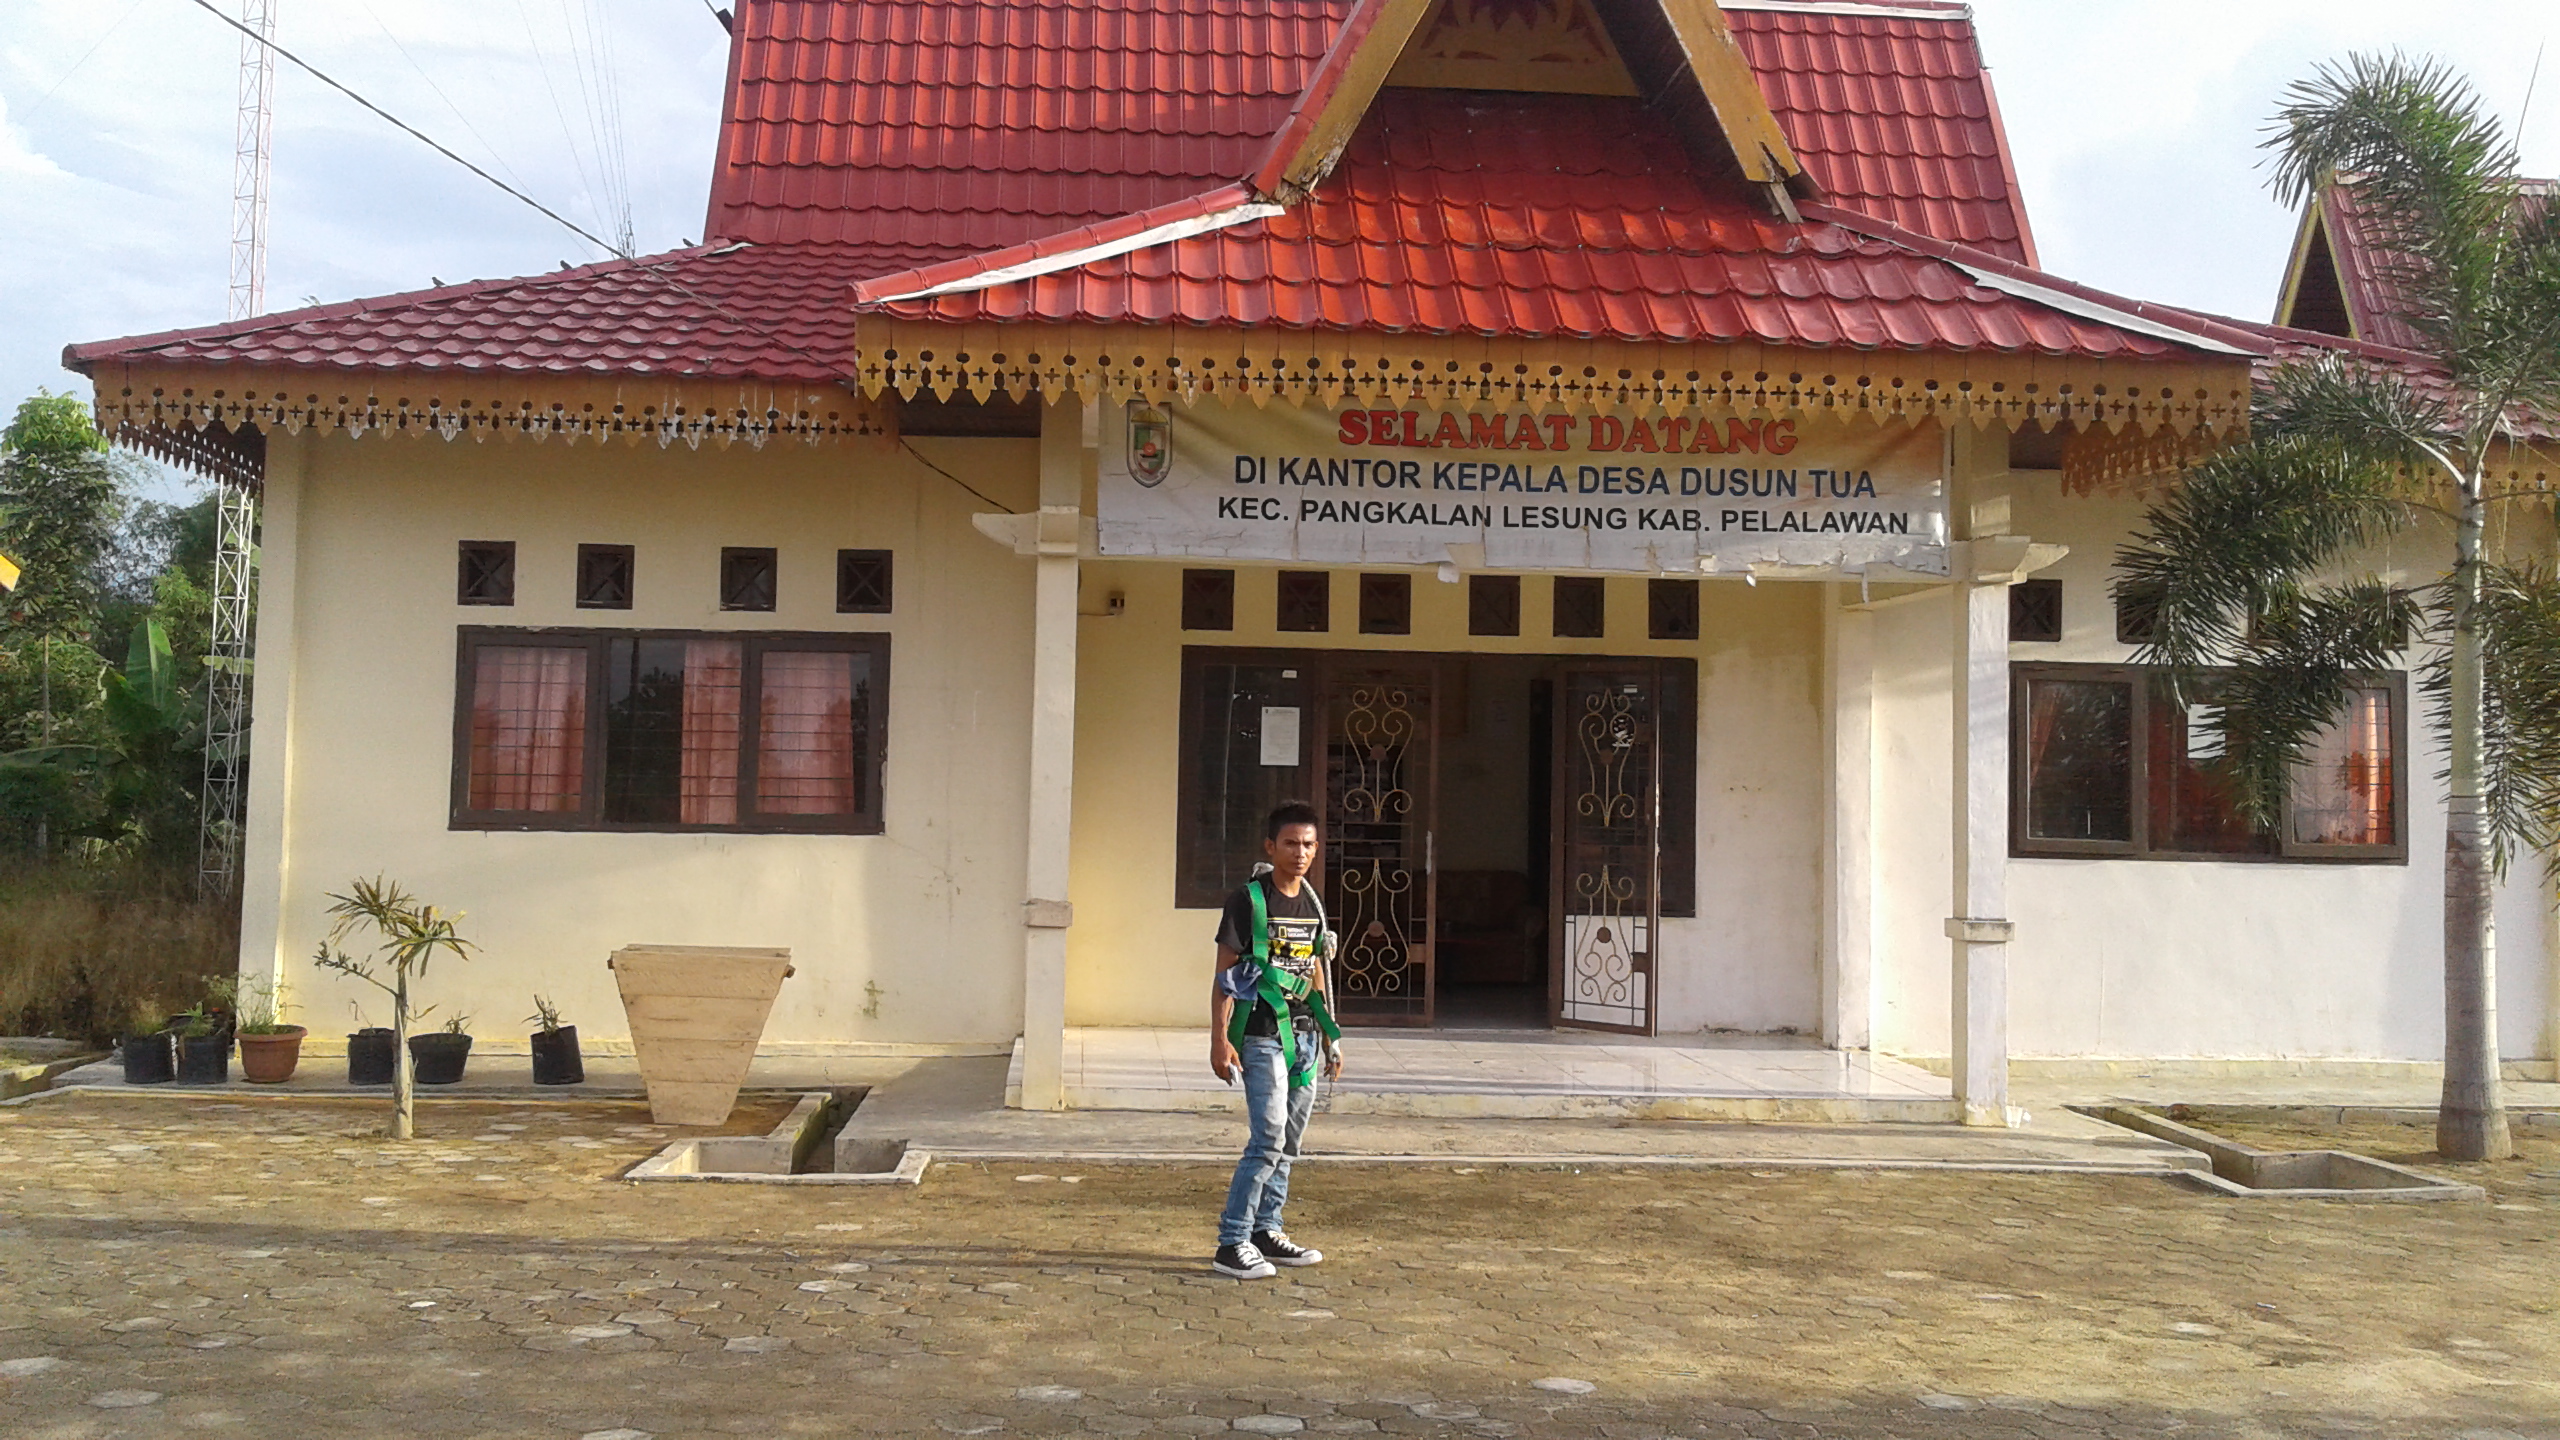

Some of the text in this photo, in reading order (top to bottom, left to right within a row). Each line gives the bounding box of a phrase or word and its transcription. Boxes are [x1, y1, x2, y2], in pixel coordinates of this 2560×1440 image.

[1339, 409, 1798, 455] SELAMAT DATANG
[1235, 455, 1877, 498] DI KANTOR KEPALA DESA DUSUN TUA
[1218, 497, 1908, 534] KEC. PANGKALAN LESUNG KAB. PELALAWAN
